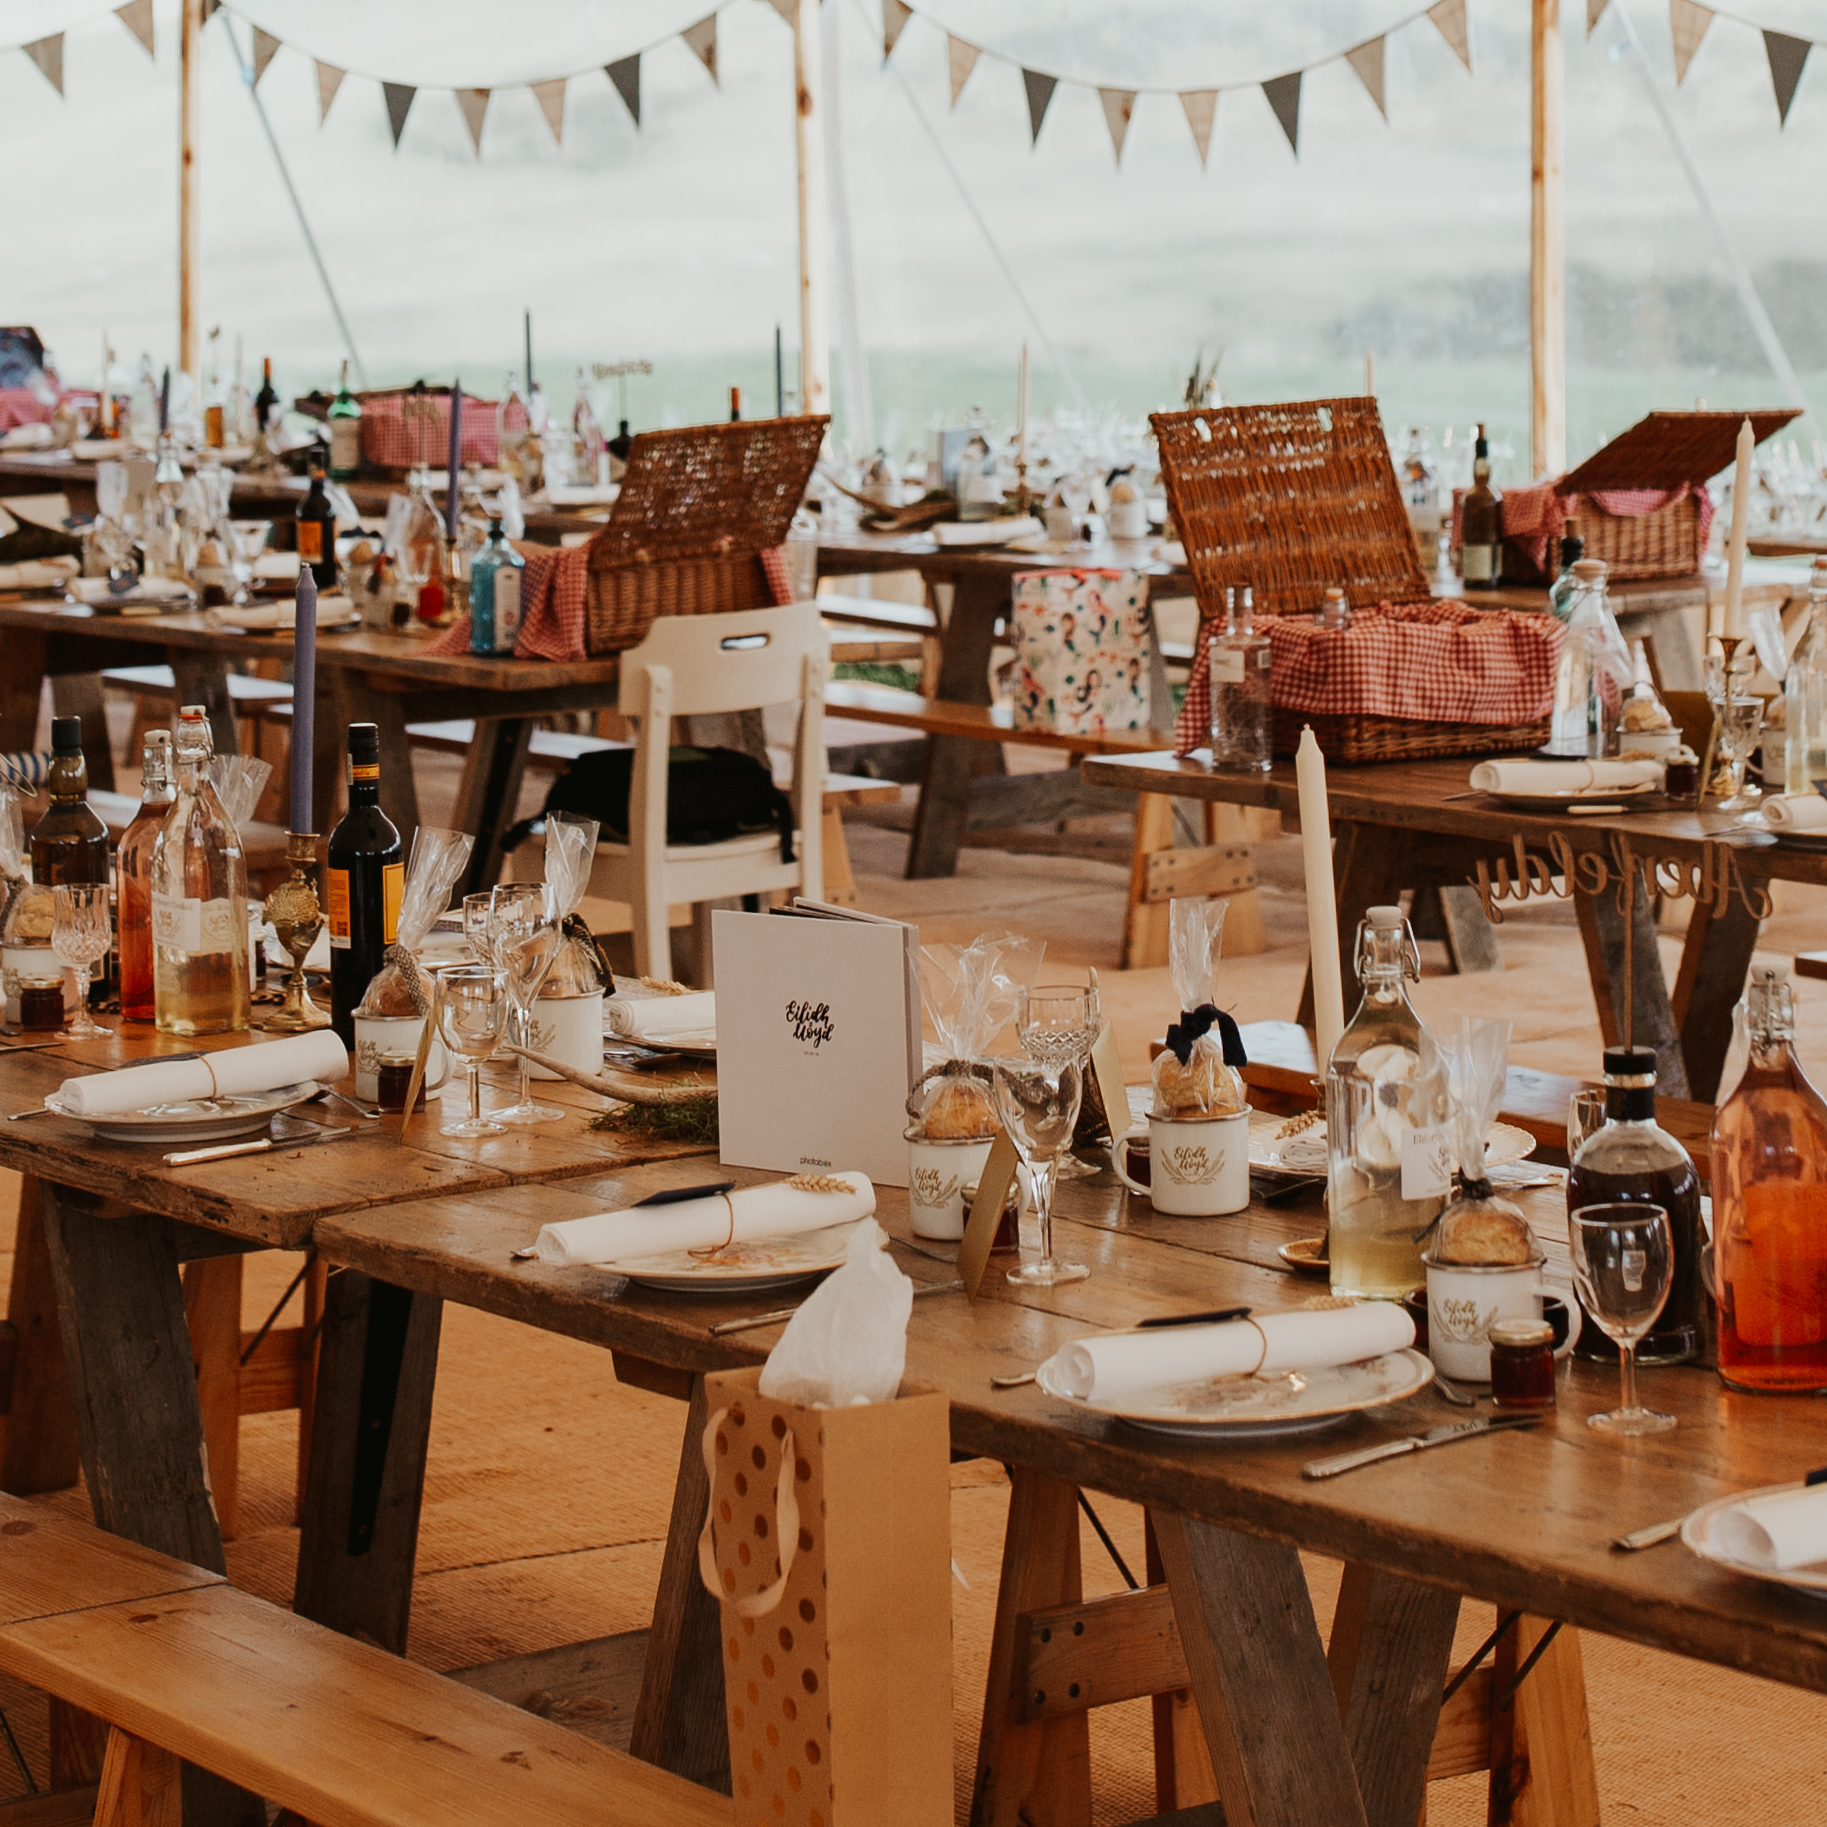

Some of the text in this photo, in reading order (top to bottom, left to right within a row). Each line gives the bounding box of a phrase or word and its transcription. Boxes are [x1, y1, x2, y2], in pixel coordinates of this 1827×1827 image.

[785, 999, 831, 1029] Eilidh
[792, 1022, 835, 1049] Lloyd
[799, 1156, 833, 1168] photobox
